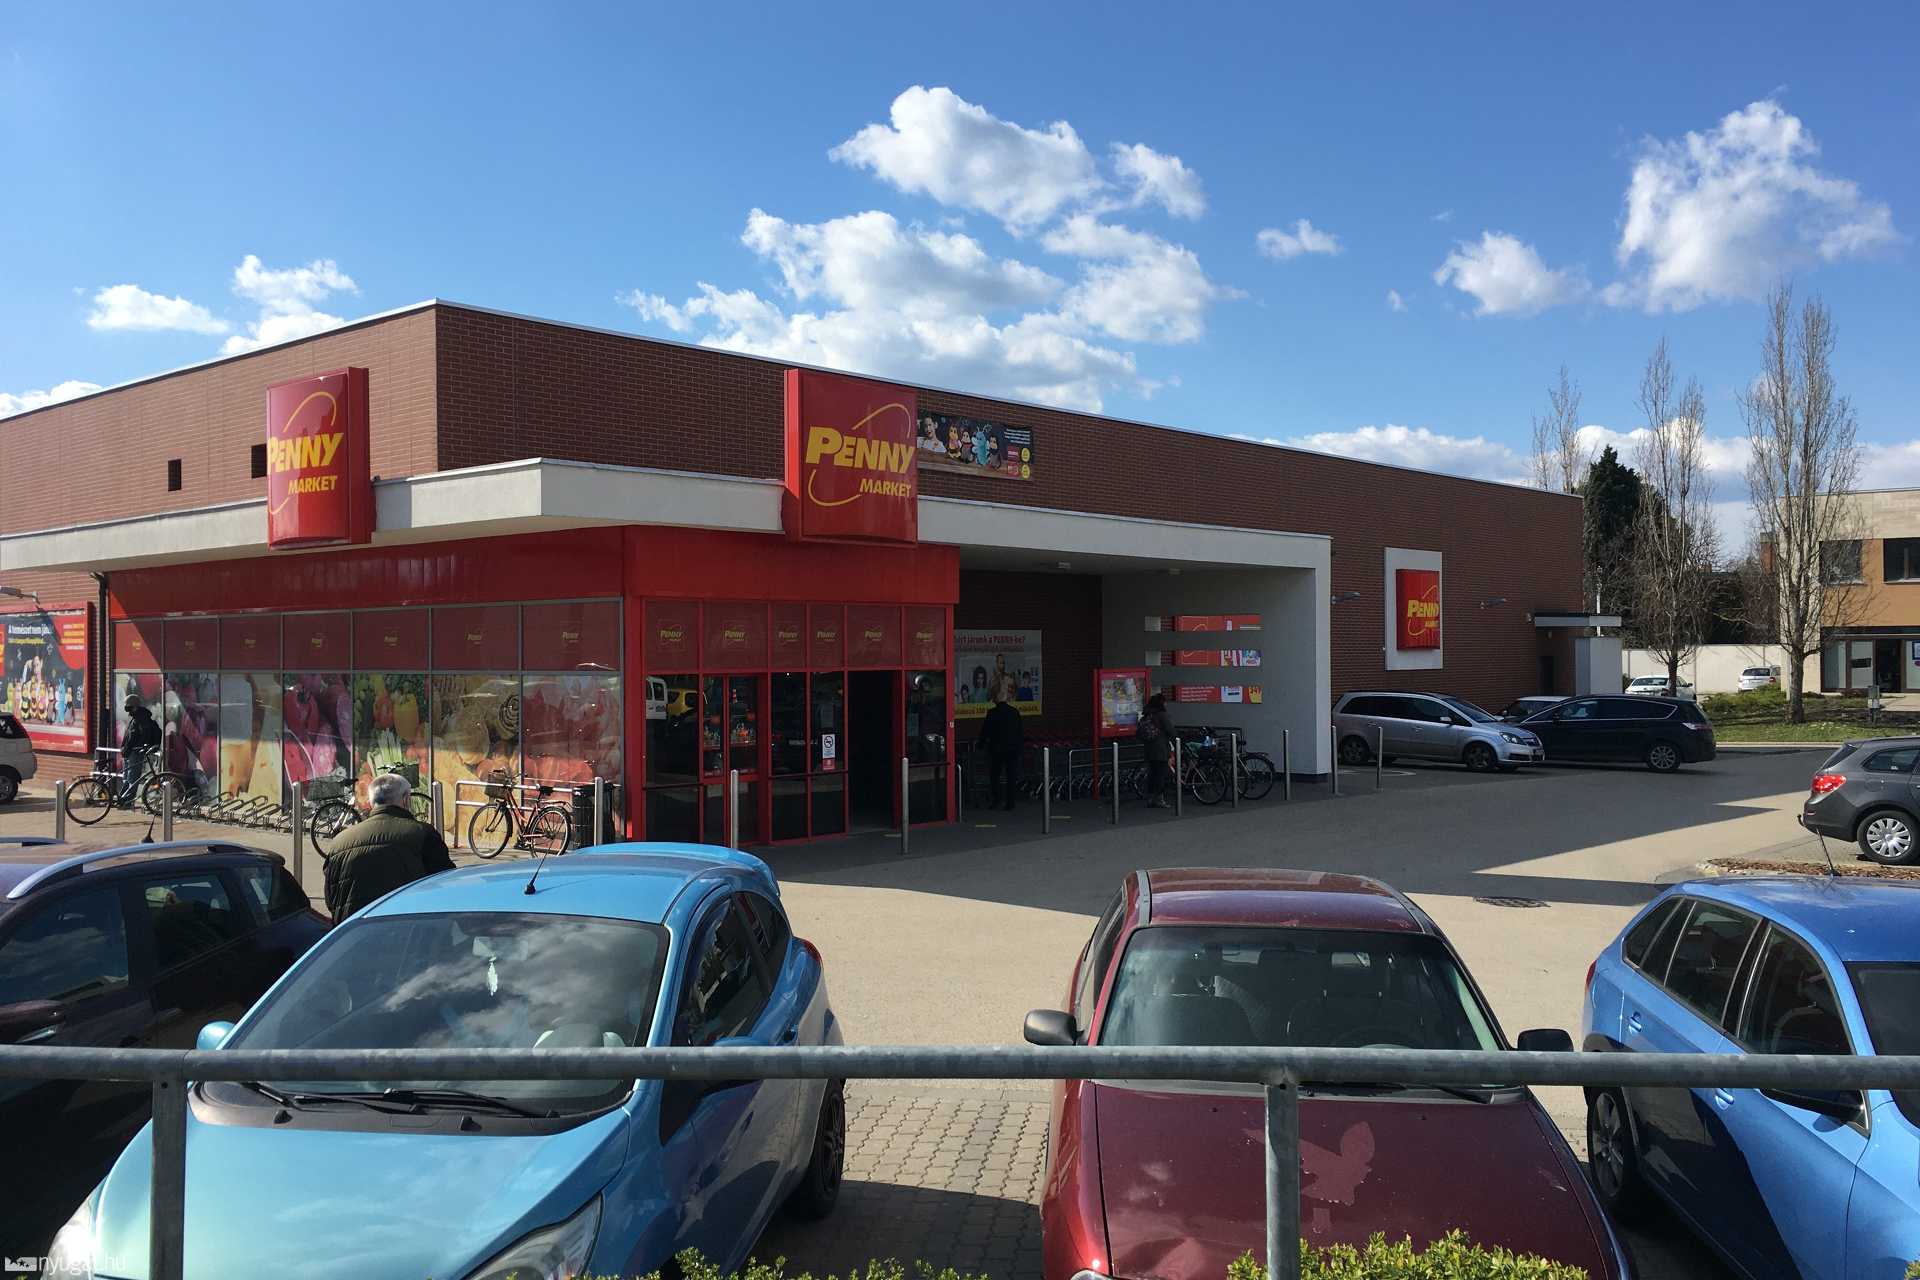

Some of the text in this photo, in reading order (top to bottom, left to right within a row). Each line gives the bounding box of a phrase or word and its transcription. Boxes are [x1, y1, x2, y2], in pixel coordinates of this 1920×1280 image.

[267, 432, 344, 472] PENNY
[806, 426, 916, 474] PENNY
[288, 475, 337, 495] MARKET
[860, 478, 912, 497] MARKET
